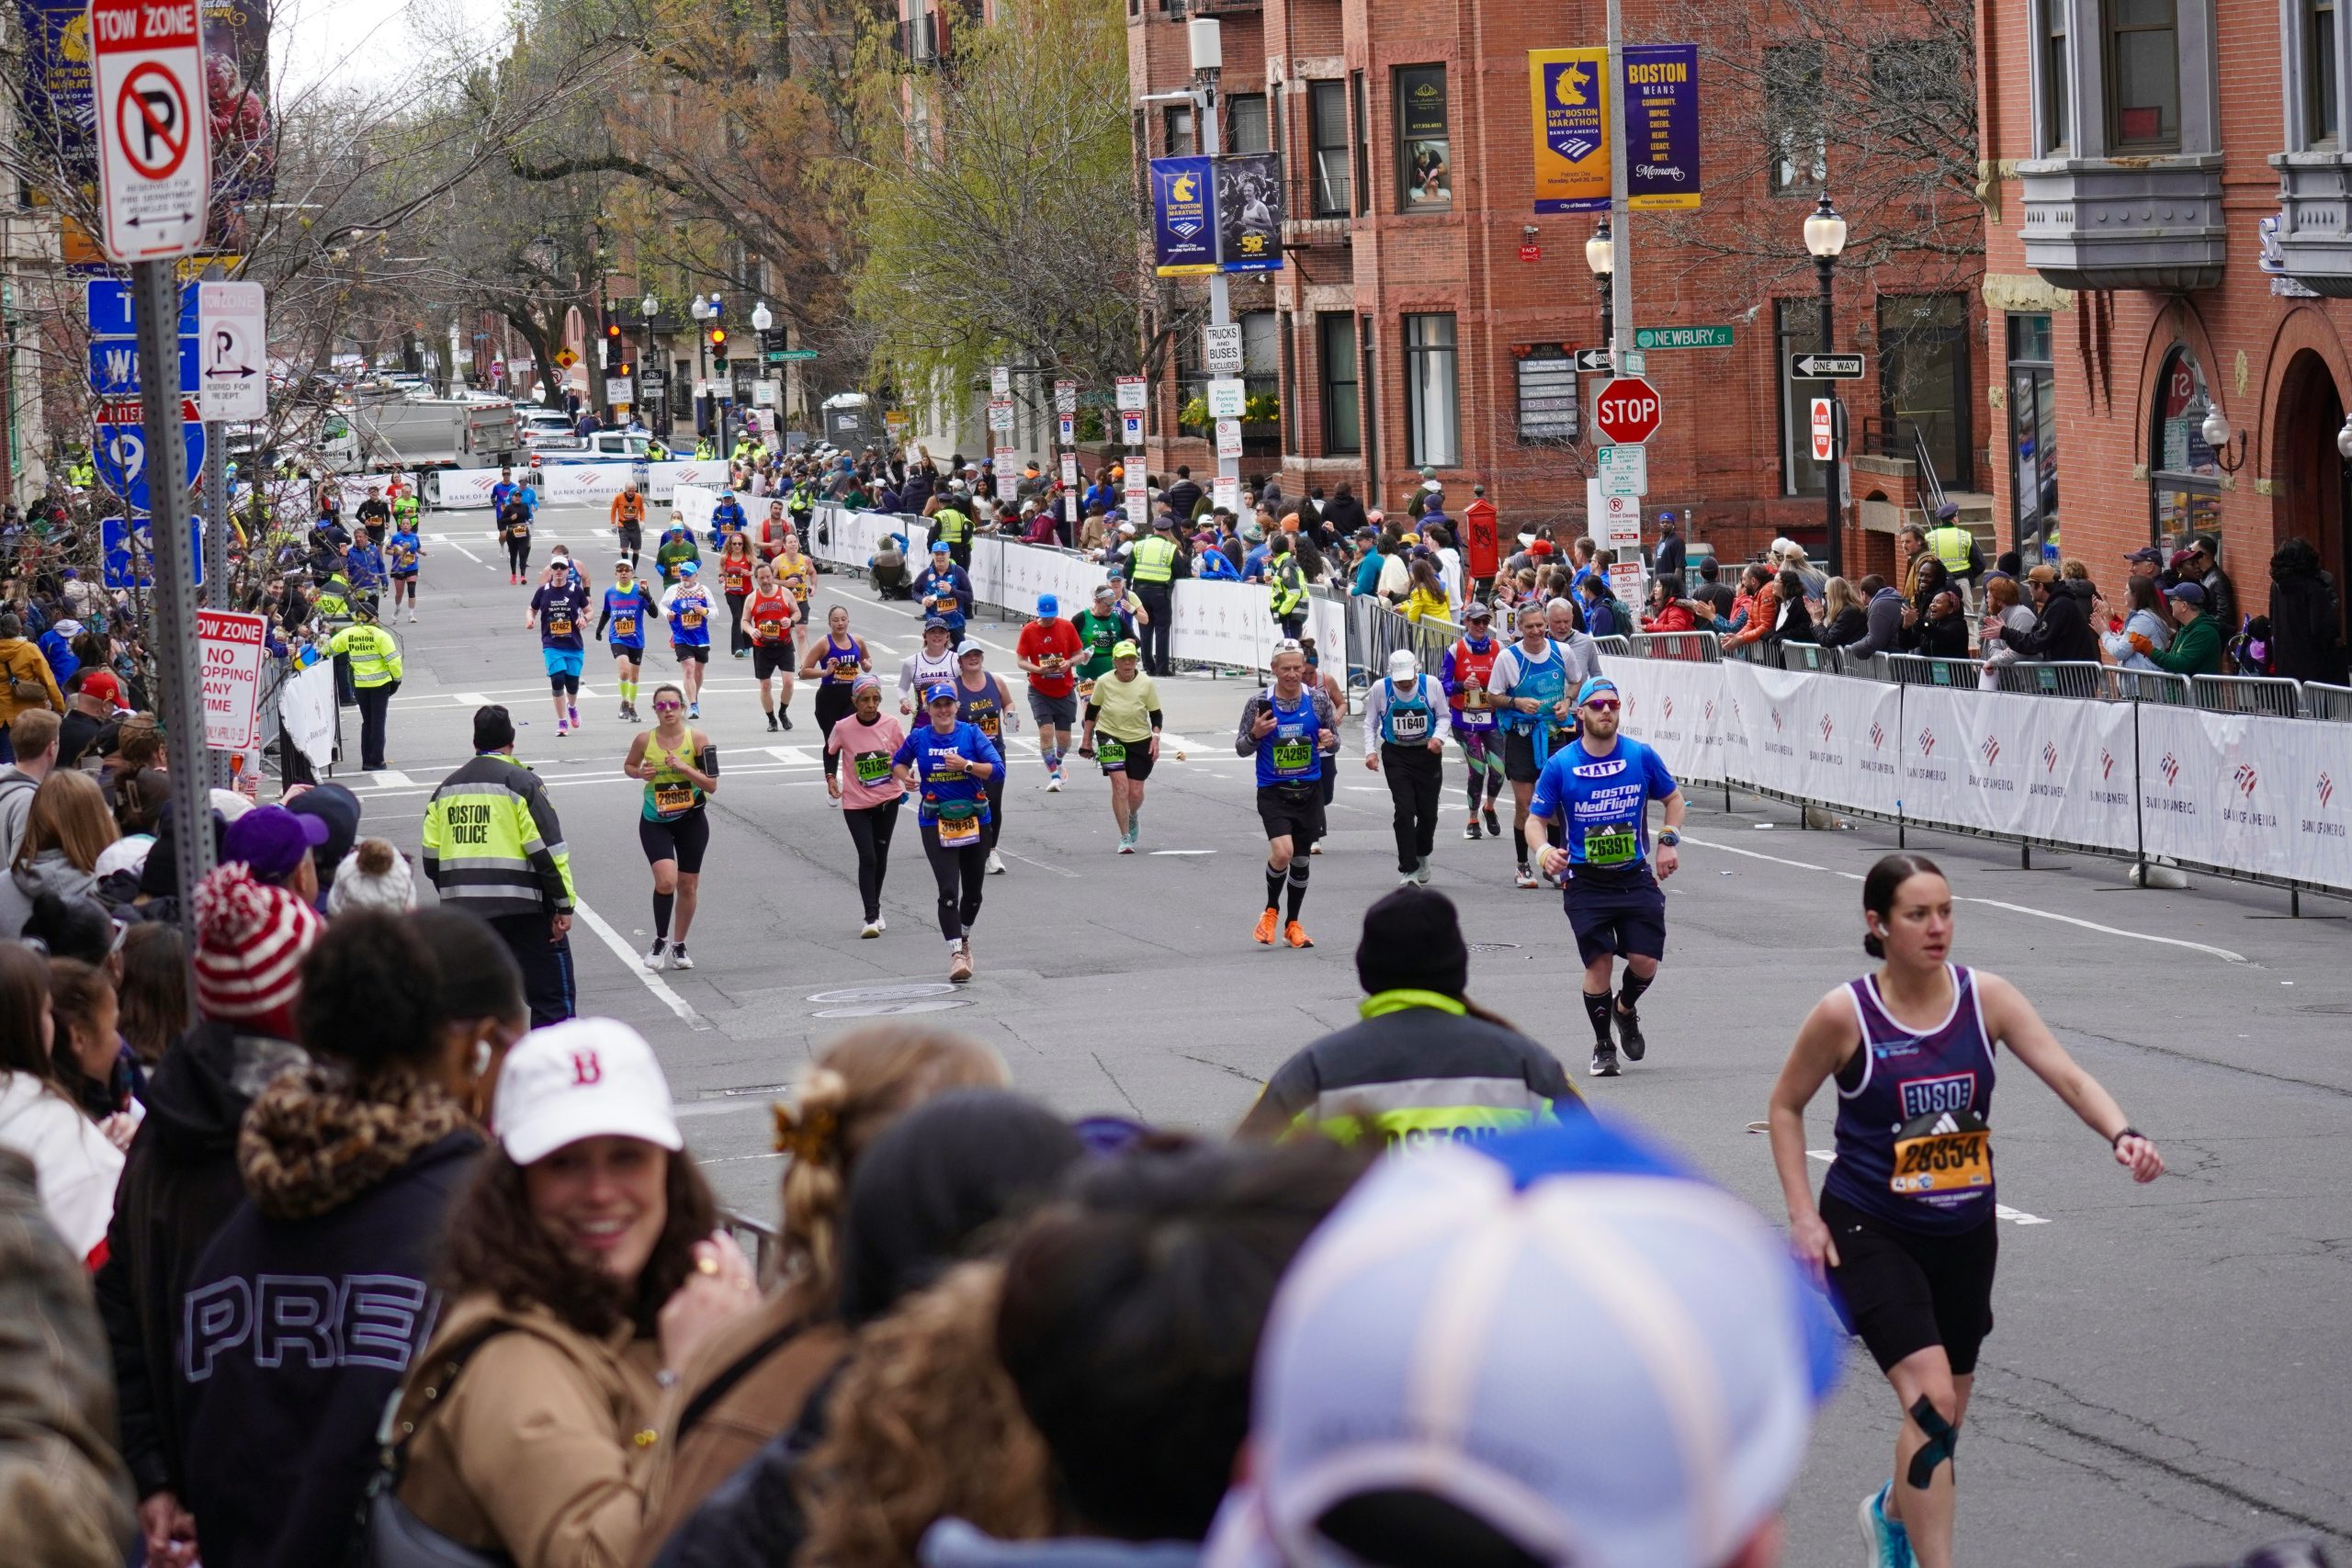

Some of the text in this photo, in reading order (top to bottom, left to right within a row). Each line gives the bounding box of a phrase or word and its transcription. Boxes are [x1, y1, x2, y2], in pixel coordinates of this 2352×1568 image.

[96, 5, 194, 42] TOW ZONE
[1628, 62, 1687, 85] BOSTON
[1643, 85, 1674, 95] MEANS
[1642, 97, 1677, 107] COMMUNITY.
[1566, 107, 1599, 118] BOSTON
[1648, 108, 1671, 118] IMPACT.
[1549, 118, 1599, 128] MARATHON
[1649, 119, 1671, 129] CHEERS.
[1651, 131, 1669, 140] HEART.
[1650, 142, 1670, 151] LEGACY.
[1169, 209, 1202, 217] MARATHON
[204, 293, 256, 309] TOW ZONE
[1207, 328, 1237, 340] TRUCKS
[1655, 329, 1726, 346] NEWBURY ST
[778, 352, 812, 360] COMMONWEALTH
[1209, 347, 1237, 359] BUSES
[1209, 361, 1239, 370] EXCLUDED
[1813, 360, 1857, 371] ONE WAY
[1528, 399, 1567, 409] DELUXE
[1600, 398, 1656, 425] STOP
[1814, 415, 1829, 423] DO NOT
[1600, 449, 1611, 459] 2
[588, 487, 624, 495] AMERICA
[1623, 565, 1639, 573] ZONE
[197, 620, 261, 640] OW ZONE
[348, 635, 375, 643] Boston
[348, 644, 375, 652] Police
[207, 648, 234, 665] NO
[840, 654, 855, 663] IZZY
[202, 682, 232, 695] ANY
[970, 698, 993, 712] SARAH
[1395, 716, 1425, 731] 11640
[1470, 715, 1483, 723] Jo
[928, 746, 959, 757] STACEY
[1276, 748, 1310, 763] 24295
[1579, 761, 1622, 777] MATT
[1990, 777, 2014, 793] AMERICA
[1590, 783, 1642, 800] BOSTON
[658, 791, 691, 806] 28968
[1574, 795, 1639, 815] MedFlight
[447, 805, 491, 825] BOSTON
[1614, 812, 1636, 821] MISSION
[452, 825, 488, 844] POLICE
[1588, 836, 1631, 858] 26391
[570, 1049, 603, 1088] B
[1917, 1080, 1961, 1113] USO
[1902, 1136, 1980, 1173] 28354
